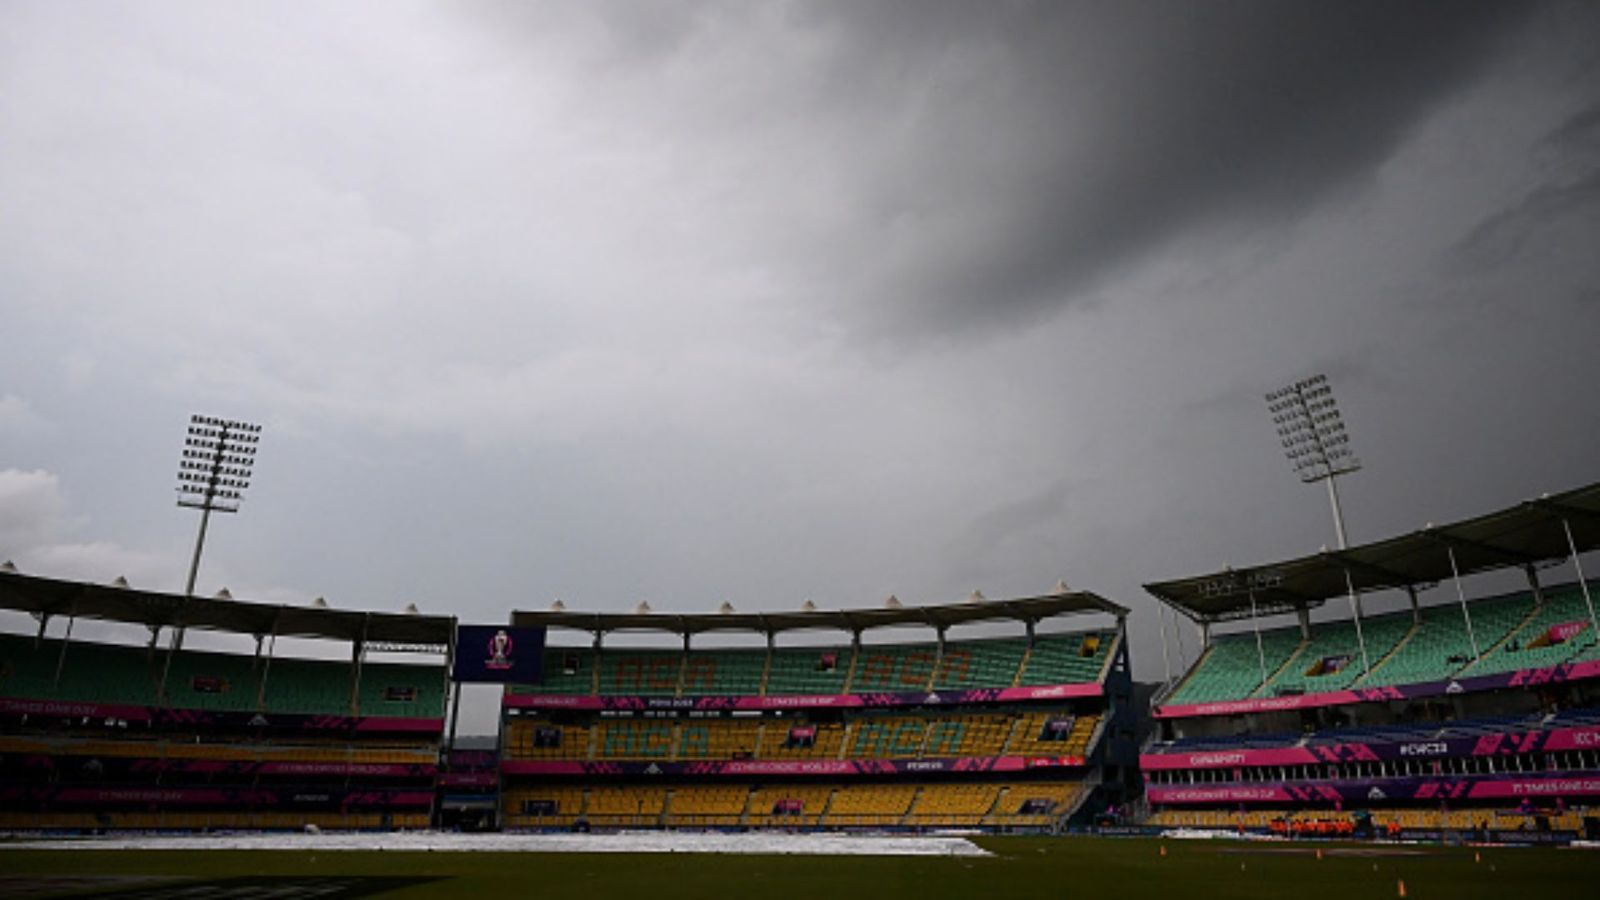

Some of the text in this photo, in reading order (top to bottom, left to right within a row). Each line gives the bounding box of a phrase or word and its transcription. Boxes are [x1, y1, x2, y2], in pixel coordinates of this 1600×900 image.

[614, 657, 717, 689] ACA
[862, 651, 971, 685] ACA
[604, 726, 709, 757] ACA
[855, 722, 965, 755] ACA
